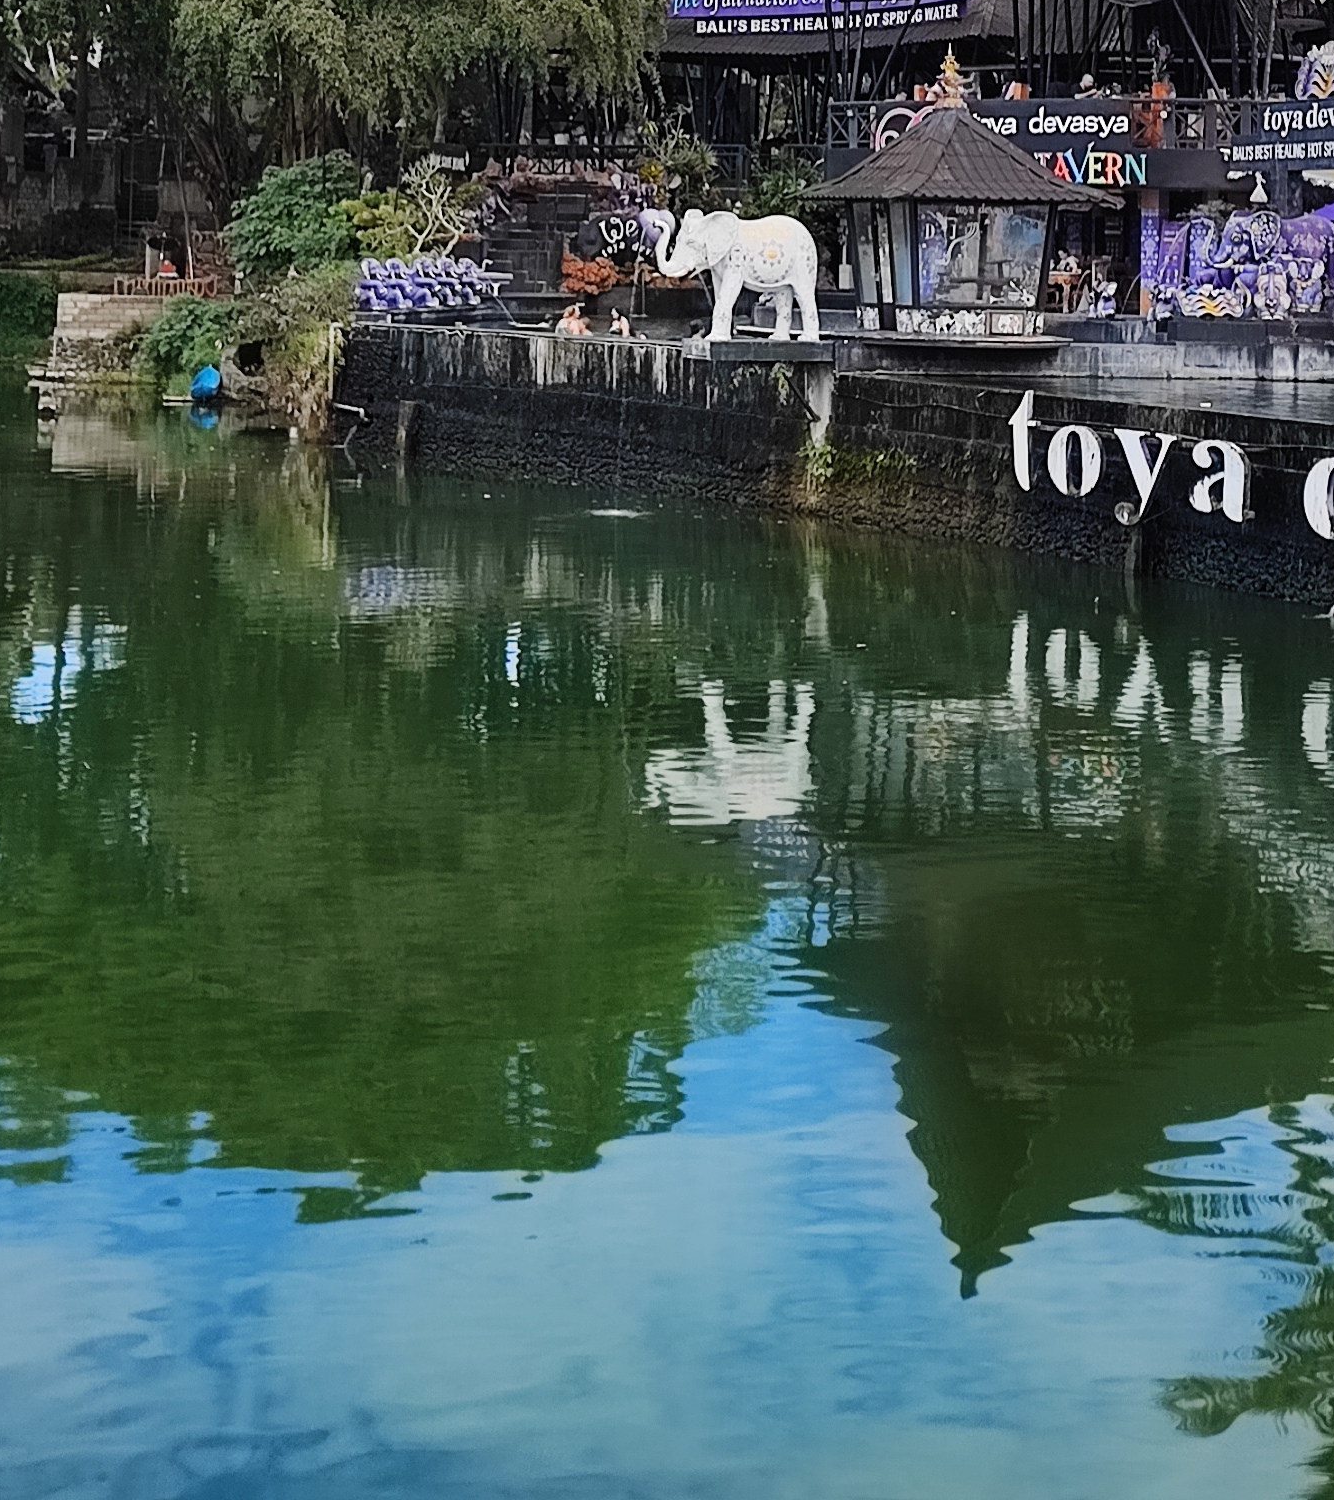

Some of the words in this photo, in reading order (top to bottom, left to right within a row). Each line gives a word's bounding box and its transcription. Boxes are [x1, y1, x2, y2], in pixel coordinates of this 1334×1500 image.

[696, 18, 748, 34] BALI'S
[750, 17, 791, 33] BEST
[924, 3, 959, 21] WATER
[972, 112, 1017, 135] ya
[1028, 105, 1129, 138] devasya
[1263, 106, 1304, 138] toya
[1254, 143, 1274, 161] BEST
[1307, 140, 1324, 159] HOT
[1008, 389, 1255, 527] toya
